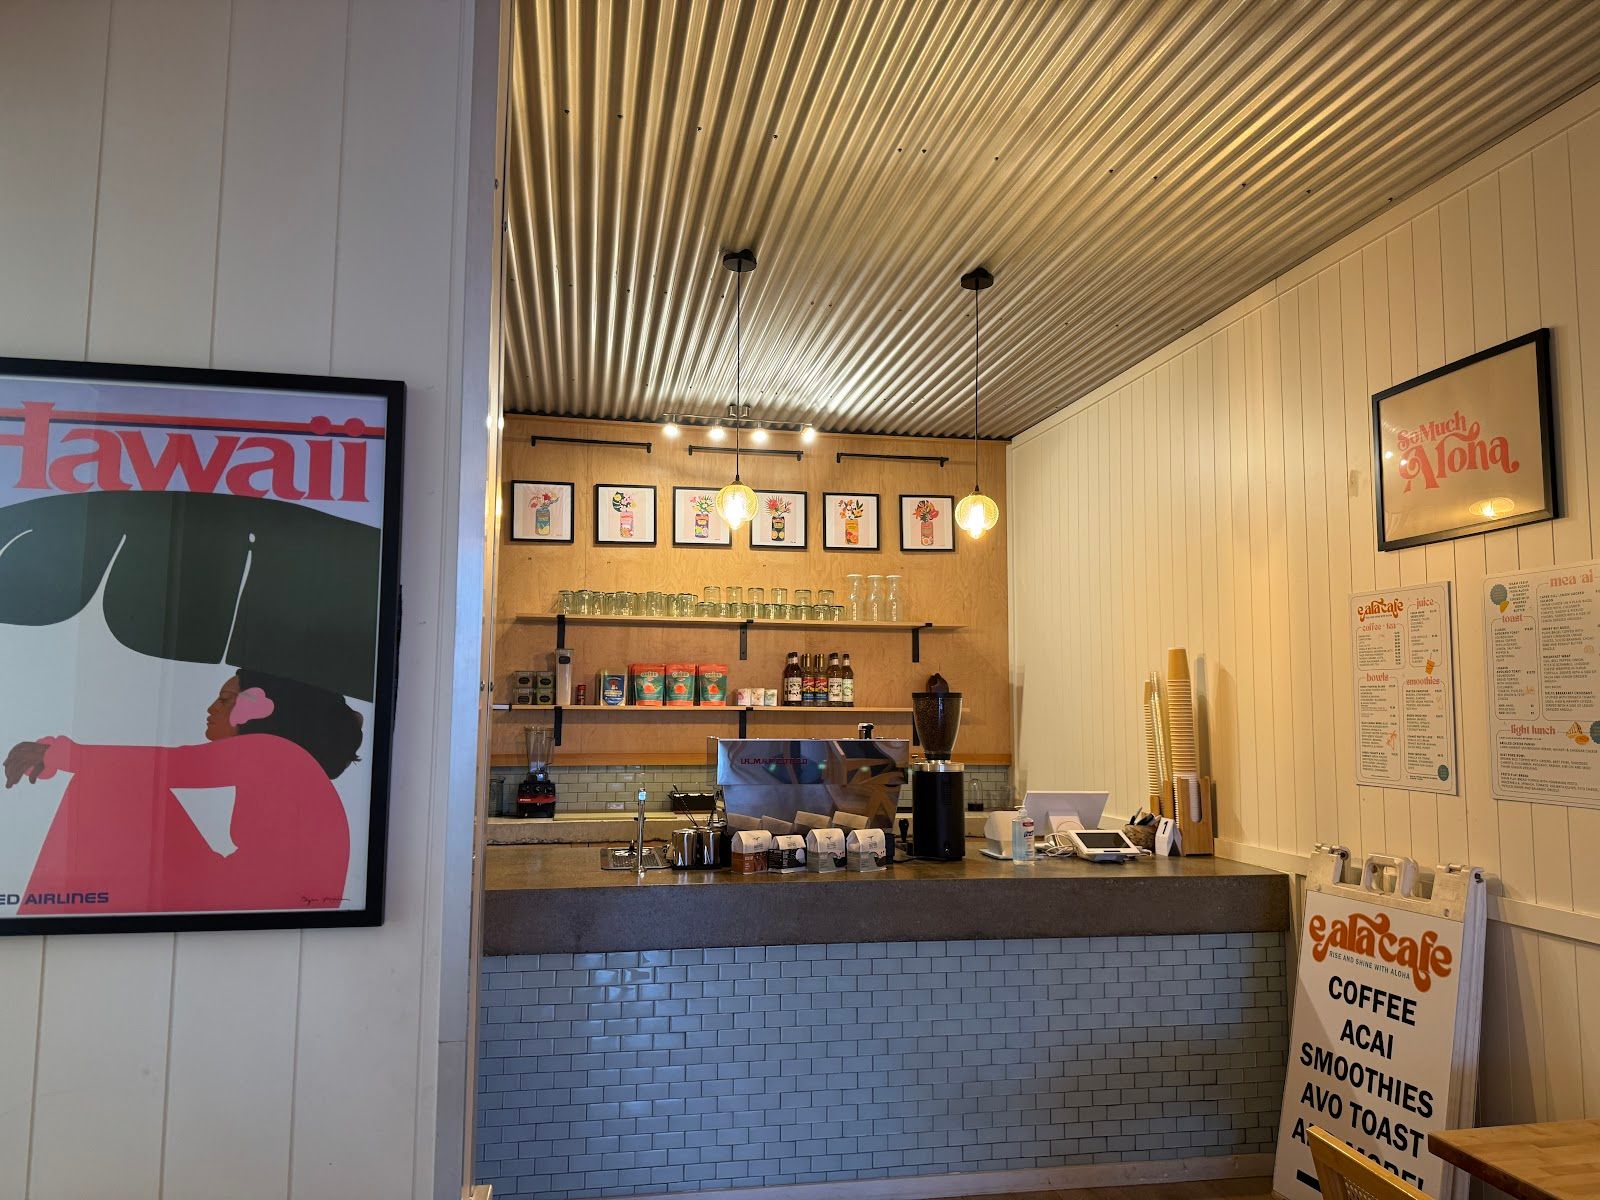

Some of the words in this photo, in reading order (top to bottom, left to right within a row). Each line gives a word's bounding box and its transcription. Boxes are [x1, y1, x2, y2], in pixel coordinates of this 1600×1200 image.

[1399, 421, 1520, 494] Aloha
[1416, 597, 1434, 610] juice
[1502, 614, 1523, 623] toast
[1362, 623, 1382, 632] coffee
[1366, 672, 1389, 682] bowls
[1406, 675, 1440, 686] smoothies
[1511, 724, 1530, 737] light
[1531, 725, 1556, 735] lunch
[1162, 820, 1169, 835] 1
[25, 892, 109, 905] AIRLINES
[1329, 950, 1342, 960] RISE
[1342, 955, 1354, 964] AND
[1355, 958, 1373, 969] SHINE
[1374, 963, 1390, 974] WITH
[1390, 968, 1411, 980] ALOHA
[1329, 975, 1417, 1027] COFFEE
[1340, 1018, 1394, 1060] ACAI
[1299, 1042, 1434, 1118] SMOOTHIES
[1300, 1081, 1343, 1120] AVO
[1349, 1100, 1425, 1159] TOAST
